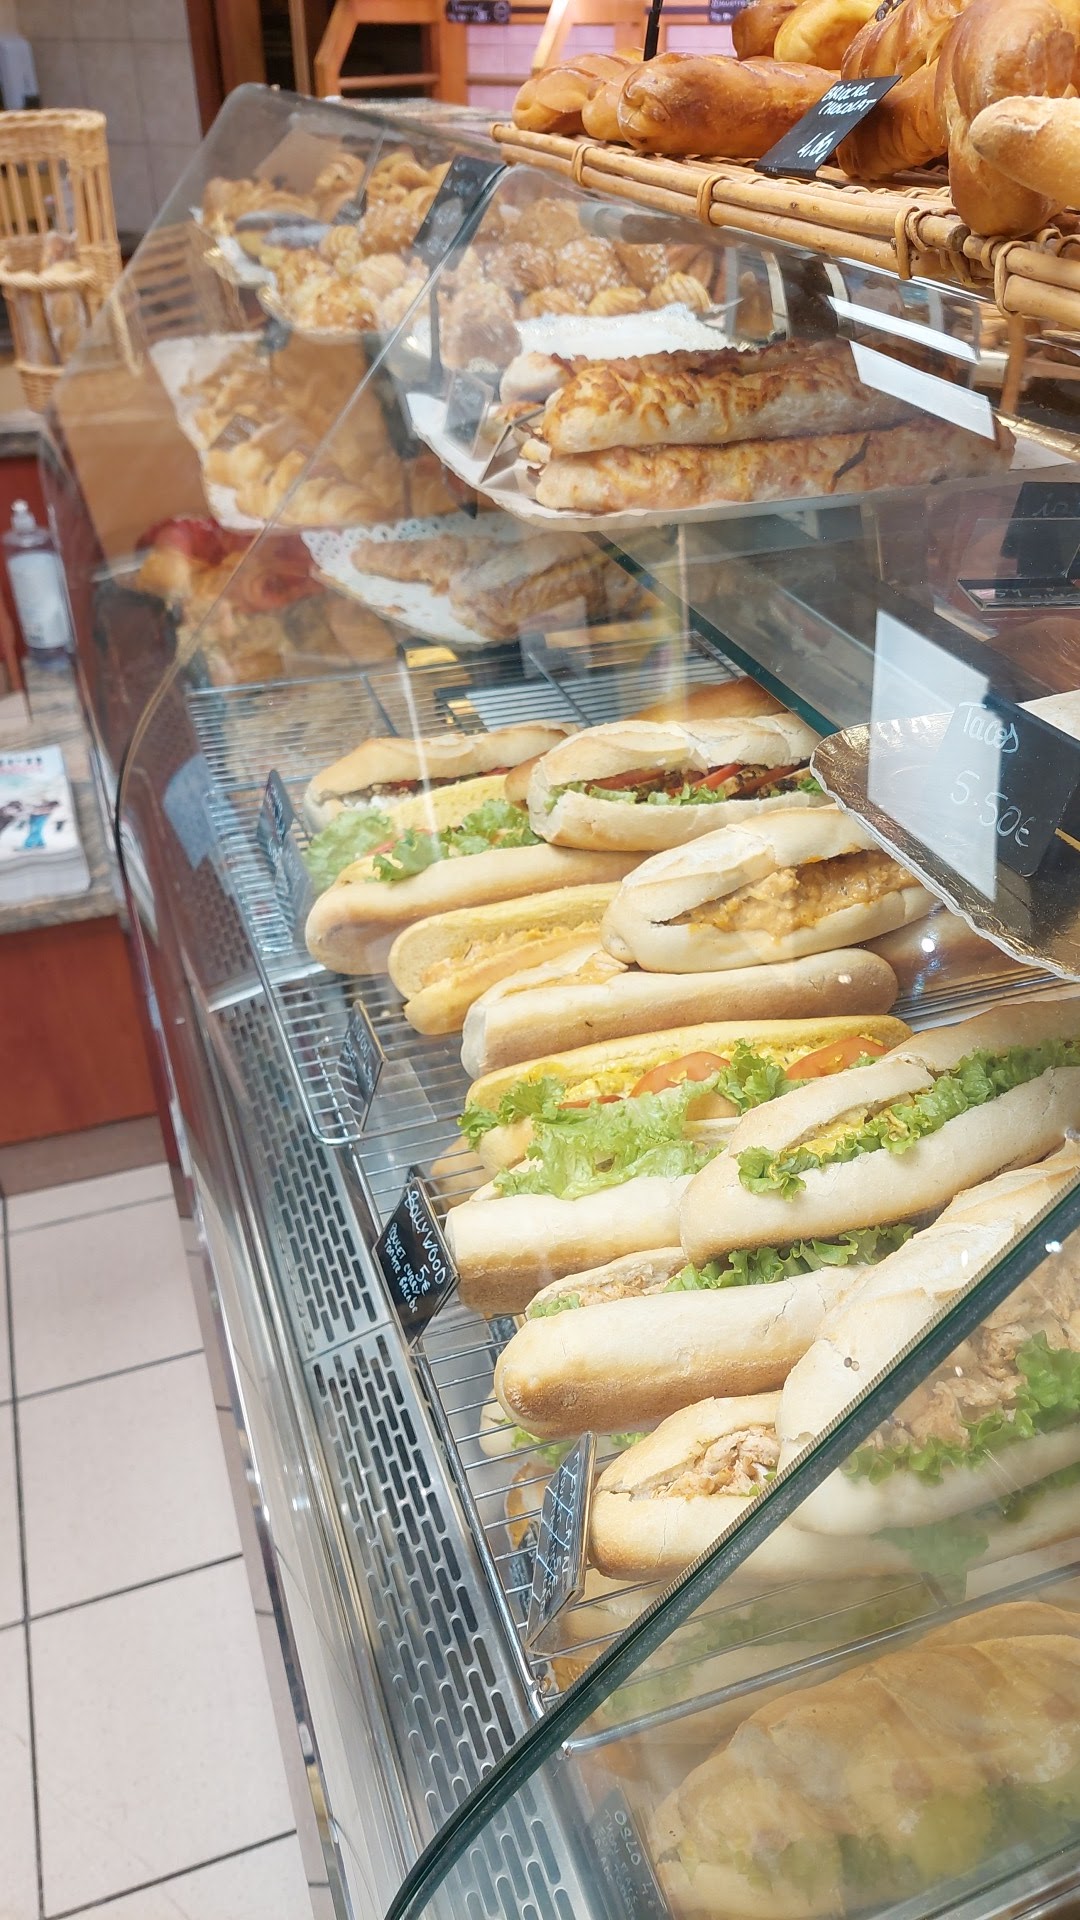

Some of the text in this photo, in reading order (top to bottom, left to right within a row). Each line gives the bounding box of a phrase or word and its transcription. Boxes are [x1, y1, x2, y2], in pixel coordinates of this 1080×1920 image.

[818, 99, 877, 115] CHOCOLAT
[958, 702, 1019, 753] Tacos
[388, 1223, 420, 1295] POULET CURRY
